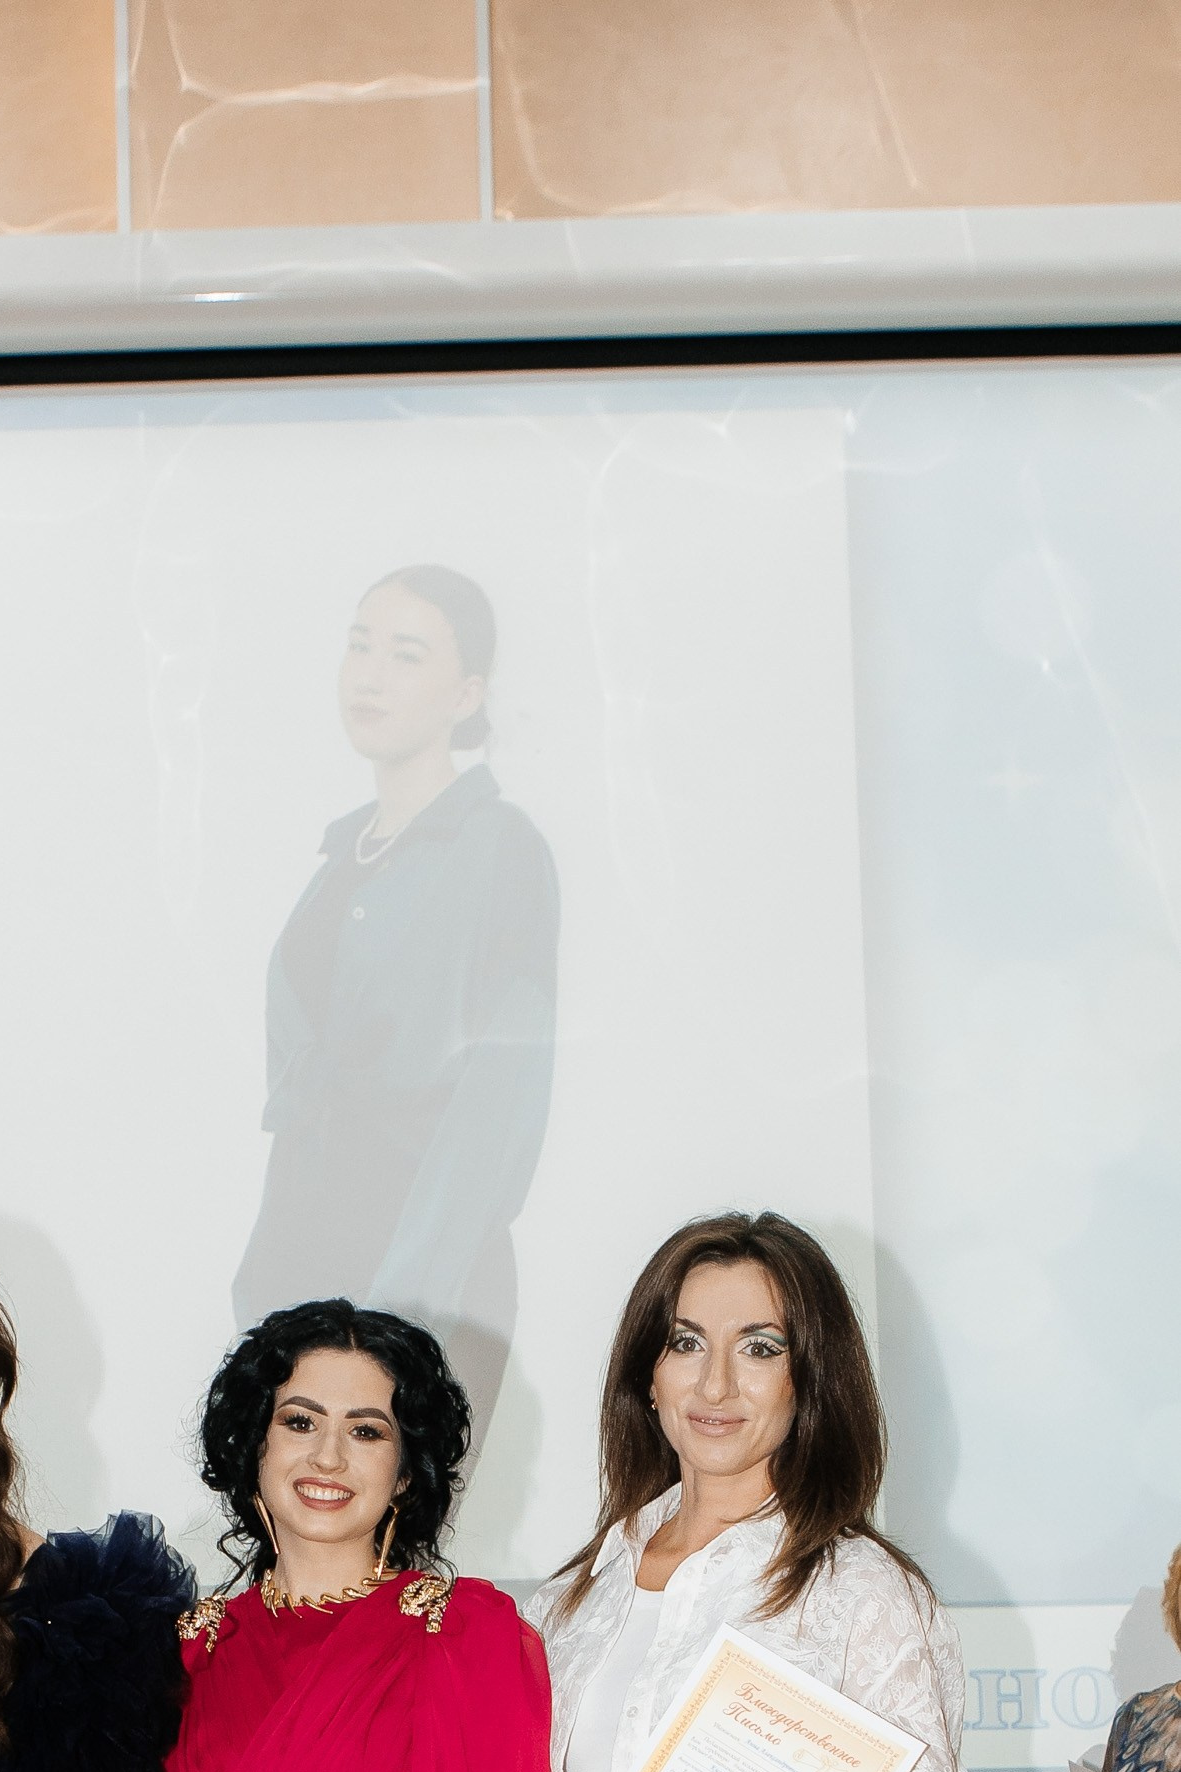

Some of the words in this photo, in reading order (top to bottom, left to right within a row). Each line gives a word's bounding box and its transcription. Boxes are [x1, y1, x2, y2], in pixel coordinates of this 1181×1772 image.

[722, 1701, 782, 1746] Письмо
[733, 1682, 861, 1768] Благодарственное
[964, 1666, 1121, 1730] НО
